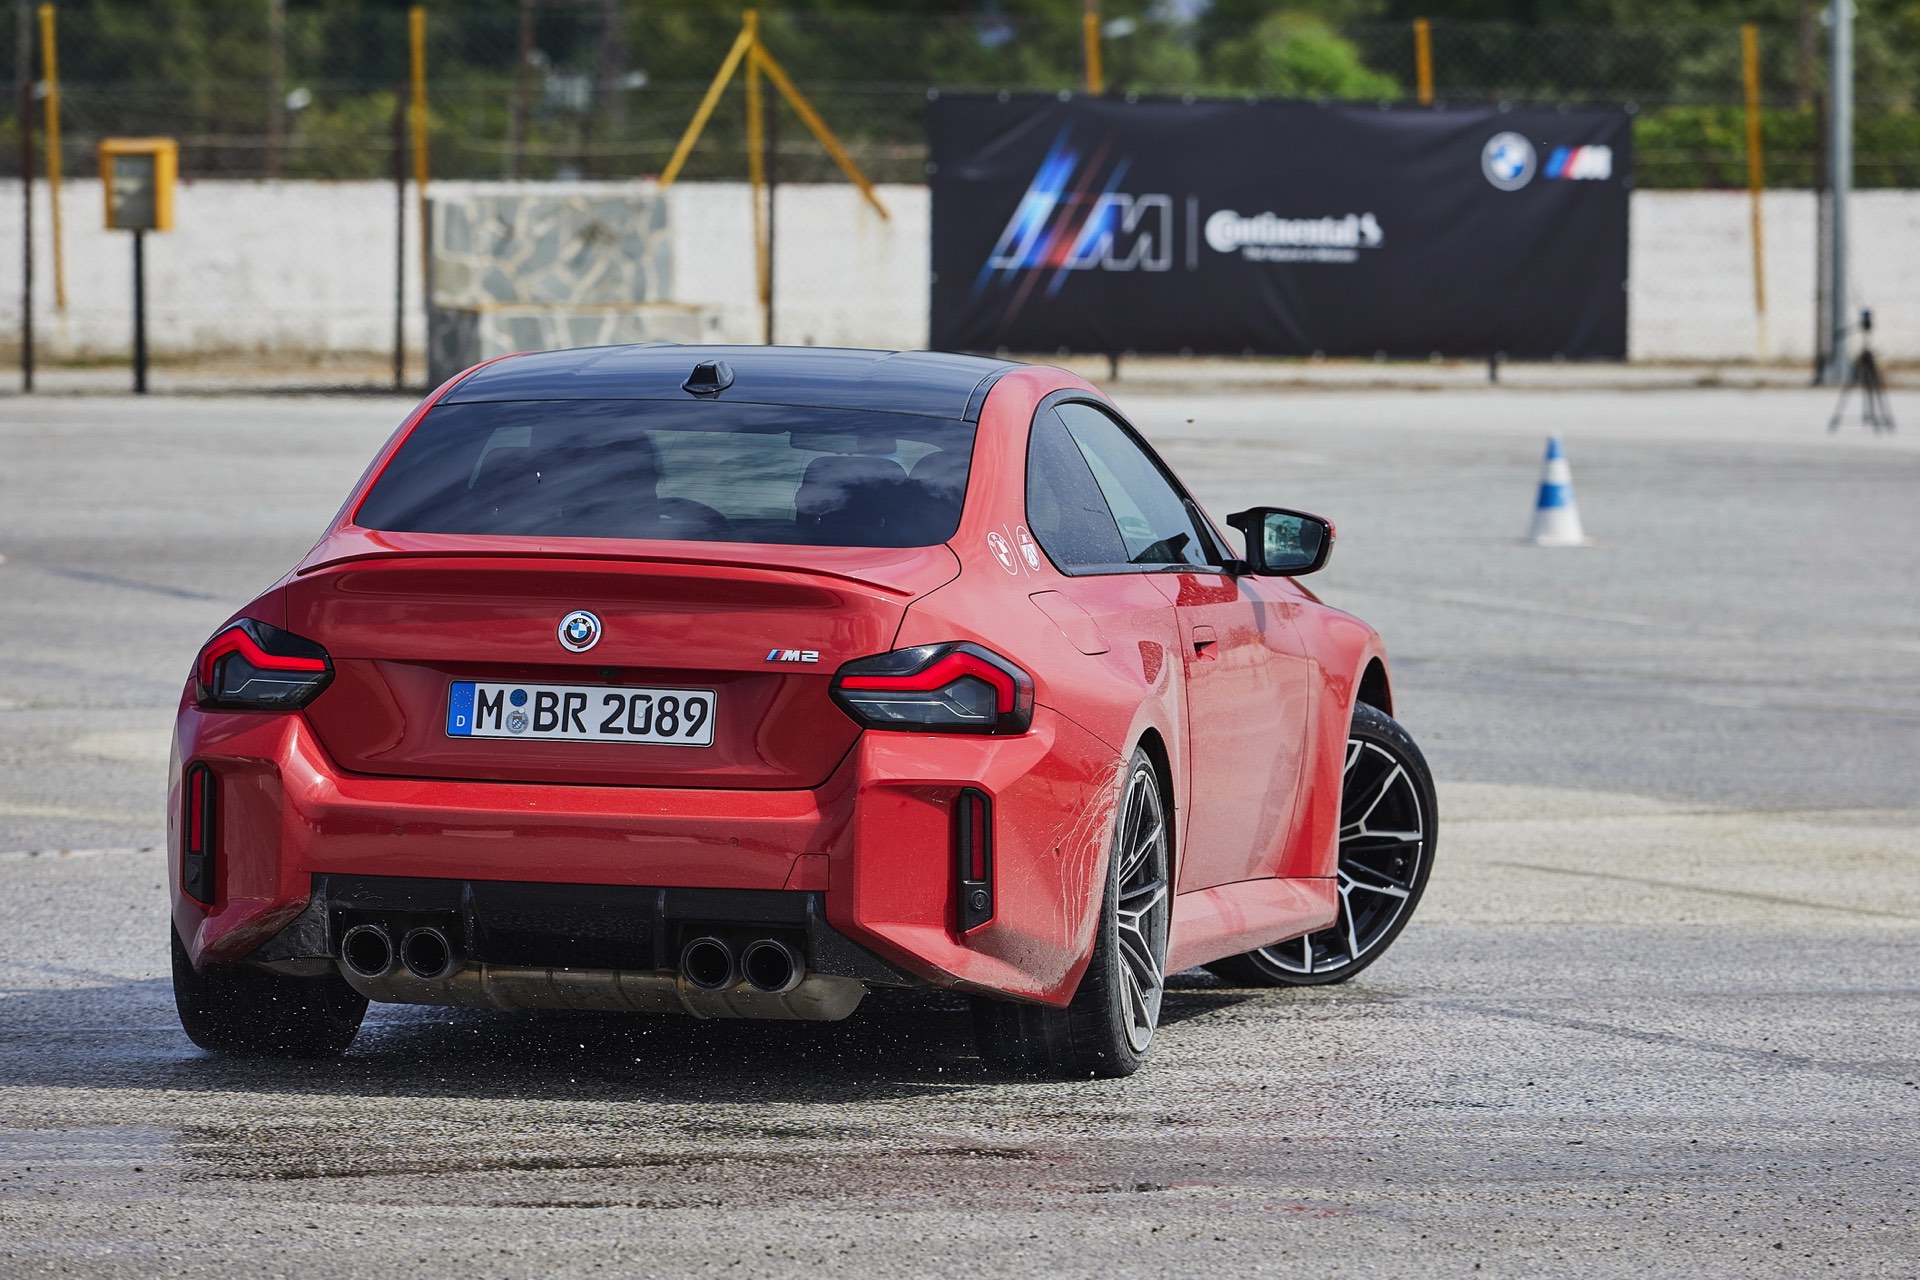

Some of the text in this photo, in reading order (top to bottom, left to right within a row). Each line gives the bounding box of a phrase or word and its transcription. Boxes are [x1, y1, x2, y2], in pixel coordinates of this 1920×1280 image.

[1205, 210, 1360, 252] Continental
[455, 715, 466, 727] D
[475, 689, 505, 730] M
[532, 691, 588, 734] BR
[599, 693, 709, 738] 2089
